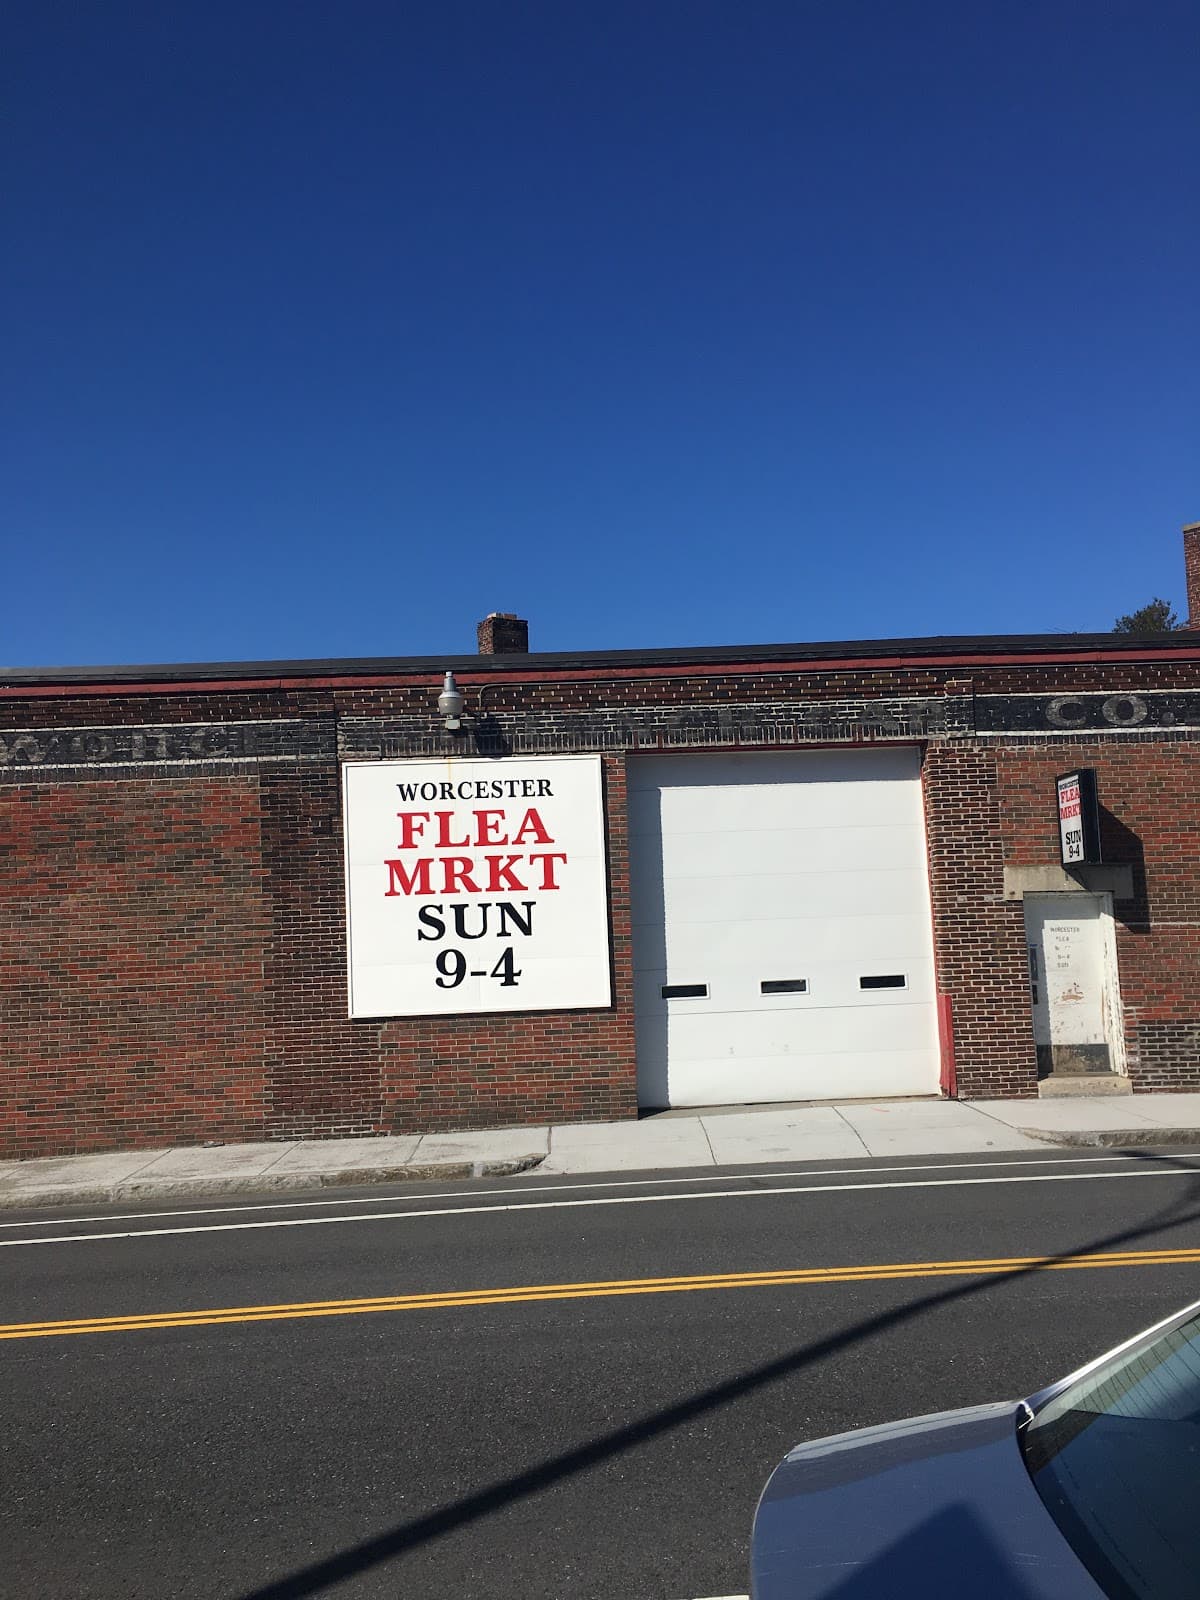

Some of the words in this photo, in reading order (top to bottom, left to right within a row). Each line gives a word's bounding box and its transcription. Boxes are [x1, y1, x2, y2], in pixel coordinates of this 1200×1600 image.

[396, 779, 554, 801] WORCESTER
[1060, 787, 1081, 803] FLEA
[397, 808, 555, 849] FLEA
[1065, 830, 1081, 845] SUN
[1068, 844, 1080, 858] 9-4
[384, 853, 568, 896] MRKT
[418, 901, 537, 940] SUN
[436, 947, 522, 988] 9-4
